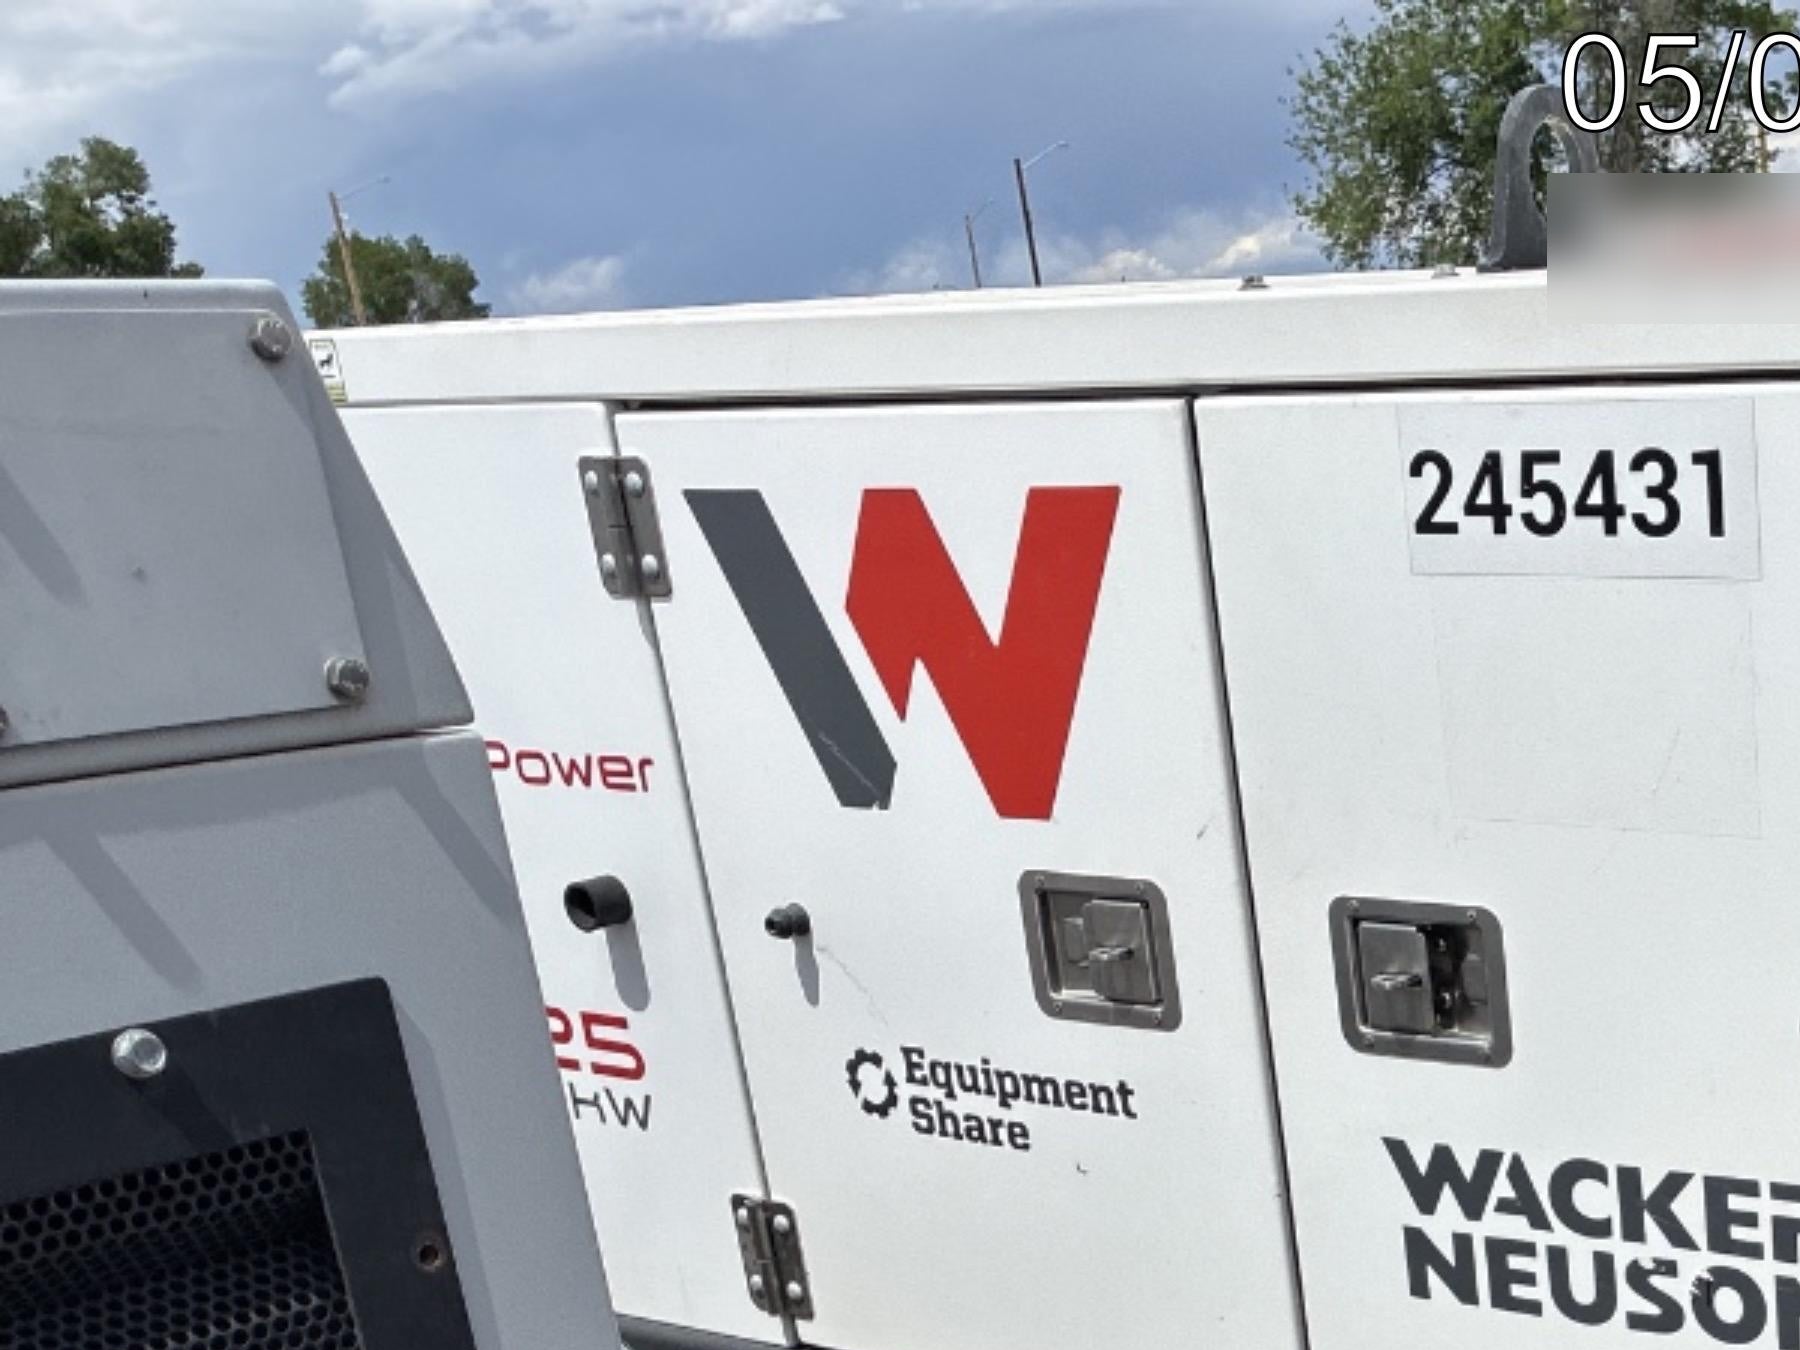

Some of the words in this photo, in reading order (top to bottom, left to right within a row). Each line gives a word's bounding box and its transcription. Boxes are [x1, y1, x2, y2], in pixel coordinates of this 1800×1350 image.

[1408, 446, 1726, 537] 245431
[899, 1045, 1139, 1120] Equipment
[907, 1096, 1032, 1152] Share
